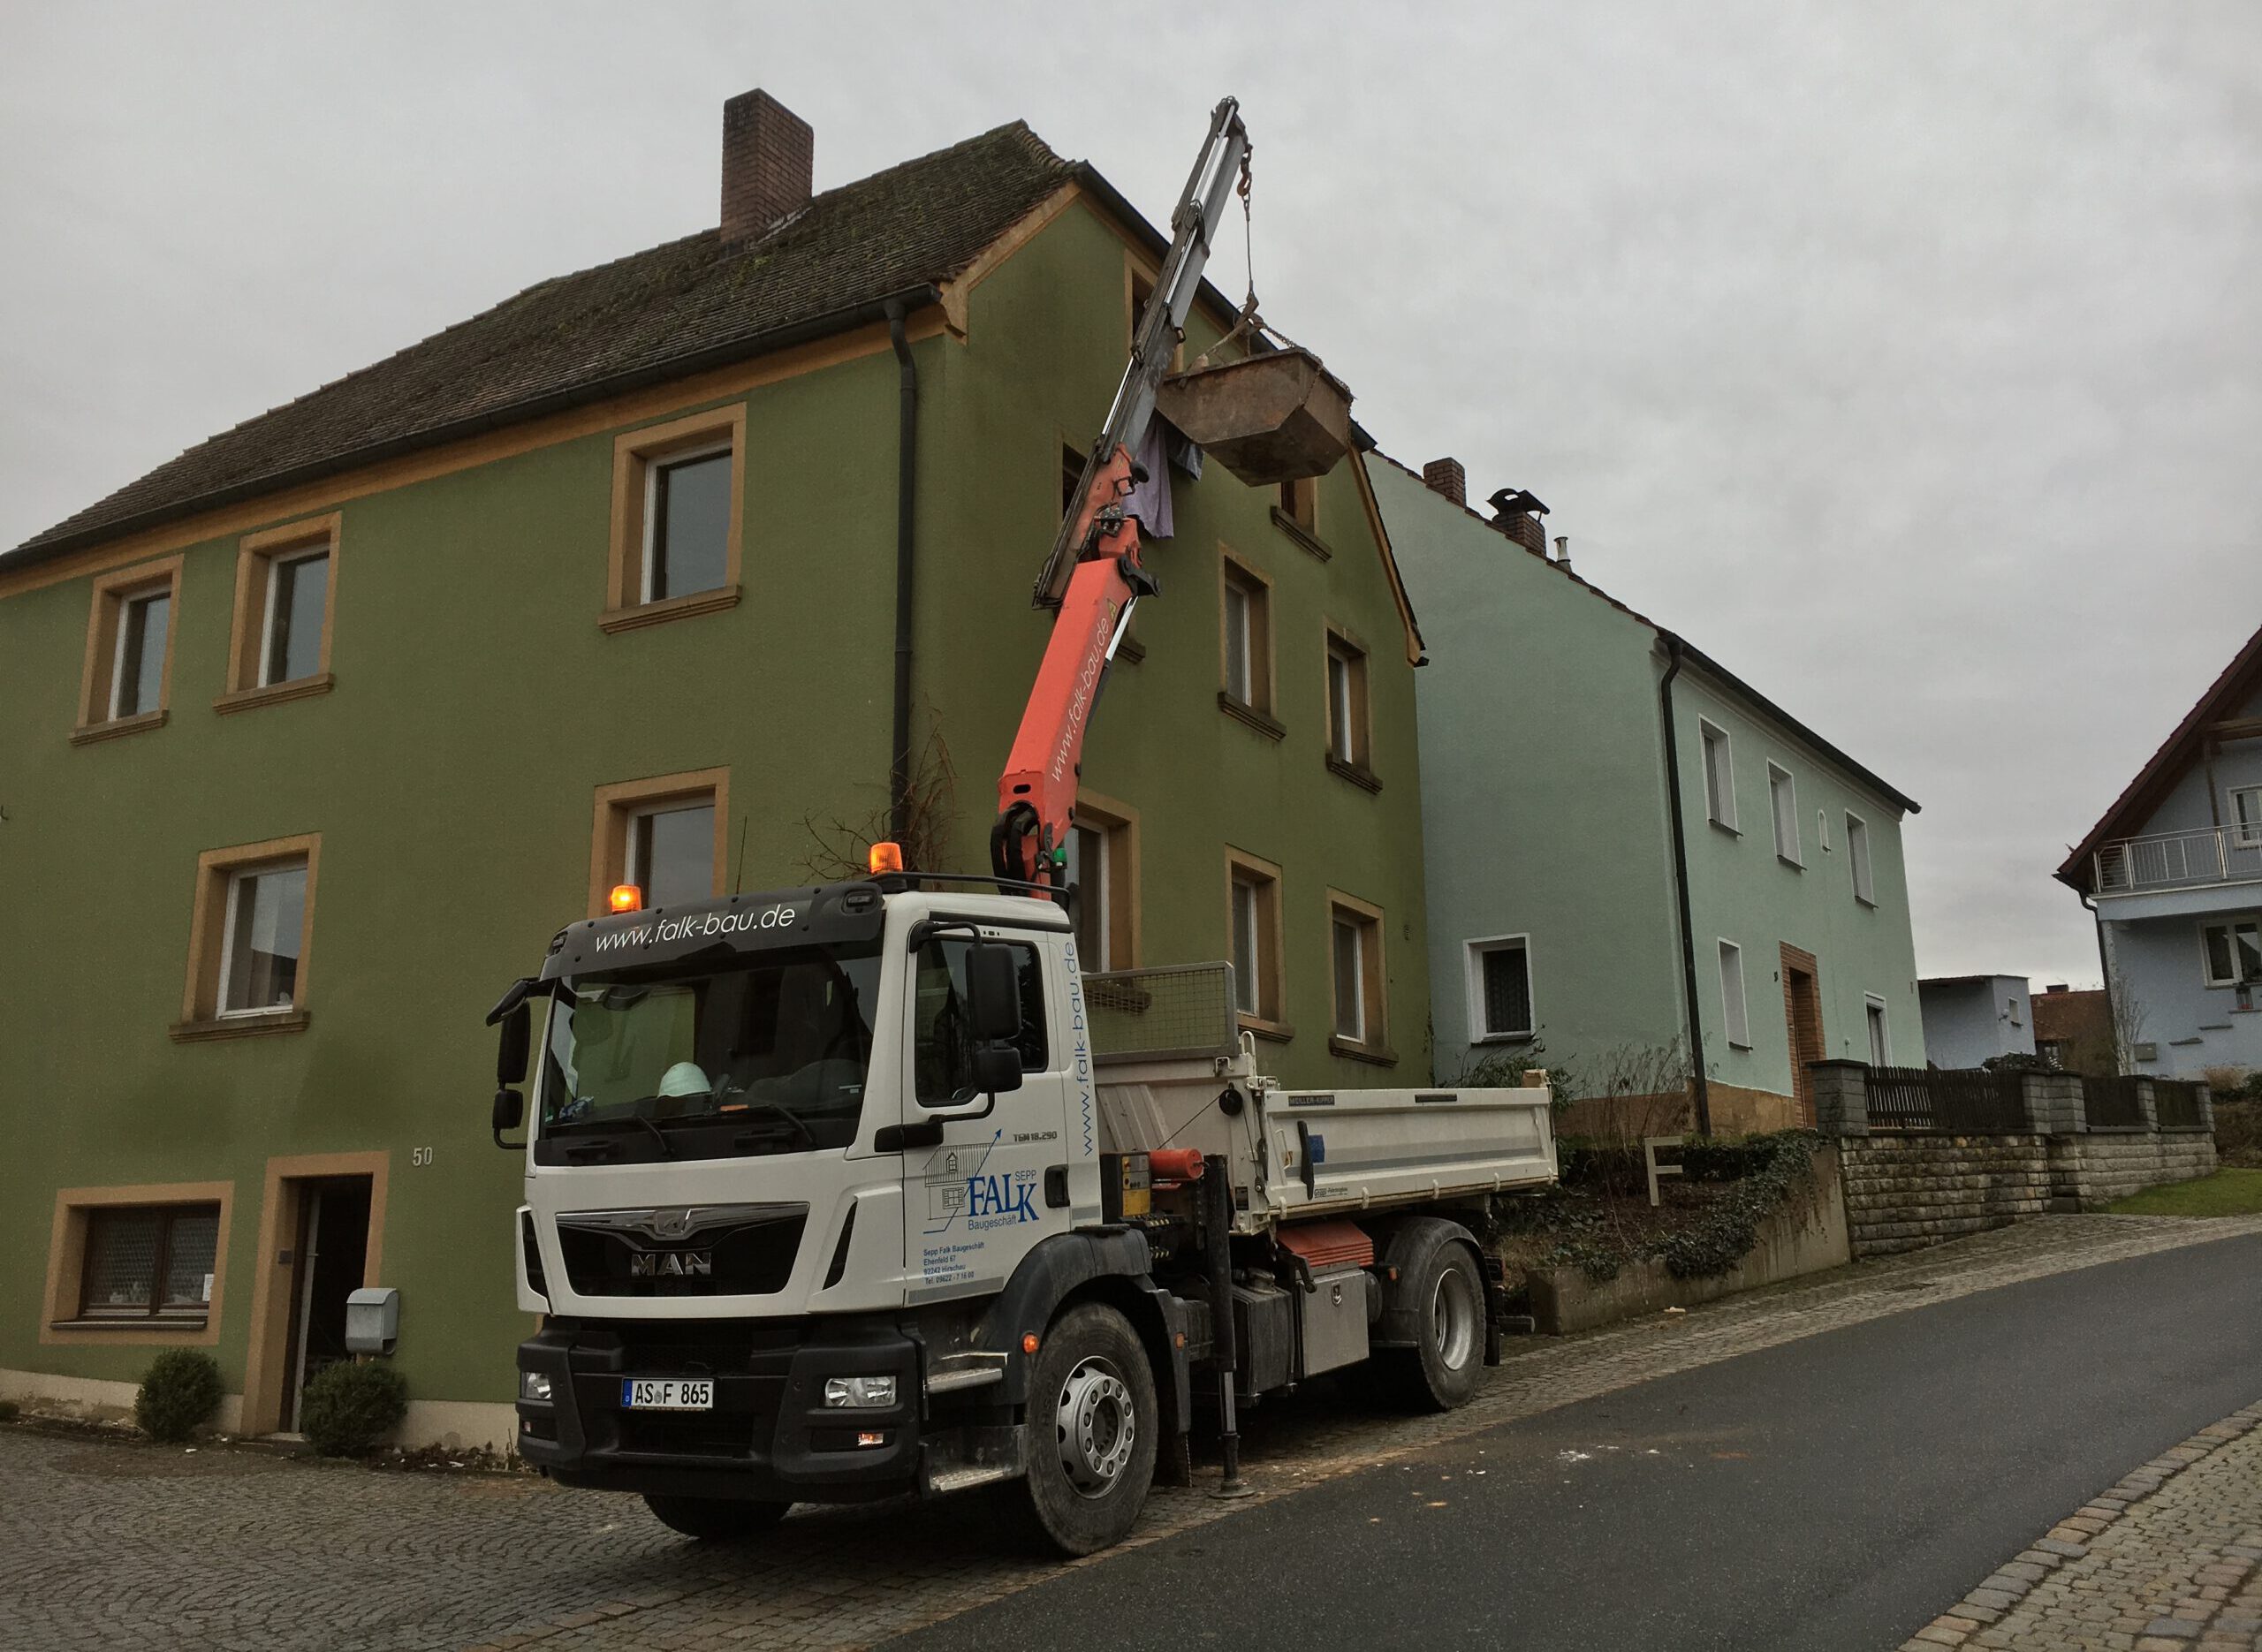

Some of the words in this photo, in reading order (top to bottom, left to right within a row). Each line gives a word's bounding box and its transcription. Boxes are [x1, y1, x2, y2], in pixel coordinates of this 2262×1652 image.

[1051, 617, 1110, 783] www.falk-bau.de
[595, 904, 796, 953] www.falk-bau.de
[1064, 941, 1094, 1156] www.falk-bau.de
[412, 1146, 433, 1166] 50
[1014, 1169, 1037, 1181] SEPP
[966, 1173, 1040, 1224] FALK
[968, 1214, 1017, 1231] Baugeschäft
[939, 1246, 951, 1254] Falk
[953, 1241, 984, 1253] Baugeschäft
[631, 1253, 711, 1277] MAN
[923, 1256, 949, 1266] Ehenfeld
[942, 1263, 967, 1272] Hirschau
[634, 1383, 654, 1404] AS
[663, 1383, 673, 1405] F
[680, 1383, 710, 1405] 865
